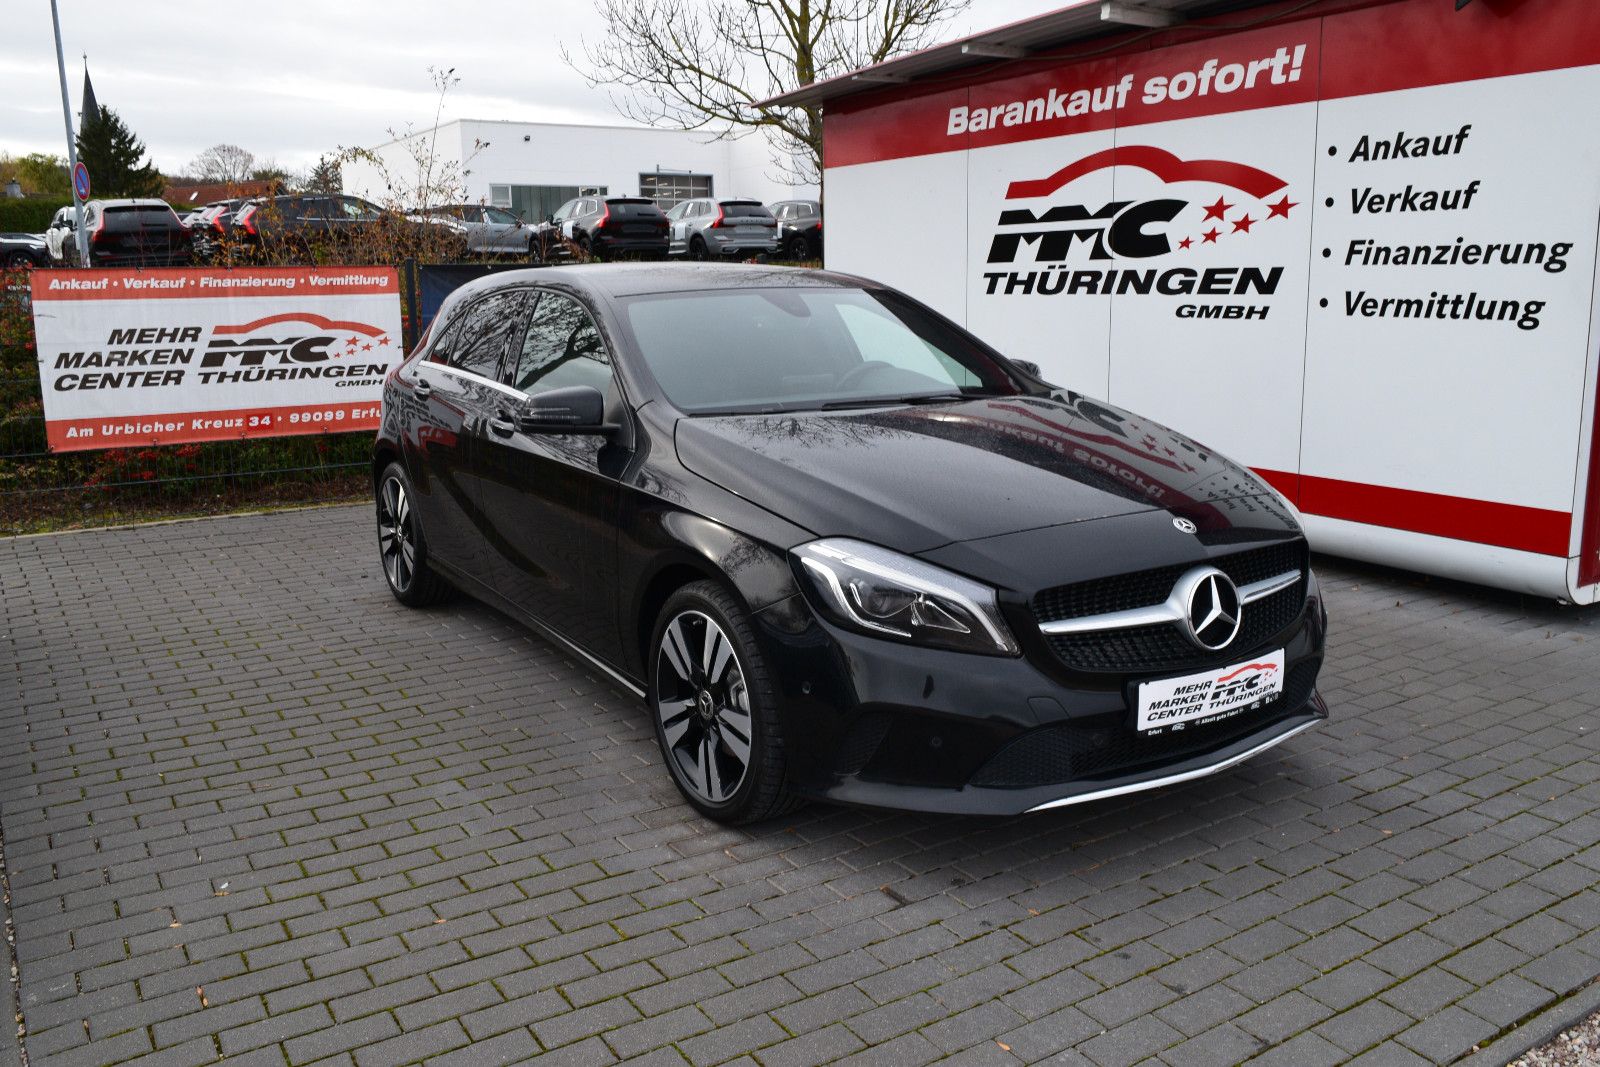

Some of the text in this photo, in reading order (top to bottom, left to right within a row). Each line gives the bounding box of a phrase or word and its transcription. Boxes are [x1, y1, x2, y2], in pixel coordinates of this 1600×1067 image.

[947, 44, 1307, 136] Barankauf sofort!
[1348, 124, 1472, 163] Ankauf
[1351, 180, 1481, 214] Verkauf
[1344, 236, 1574, 273] Finanzierung
[49, 274, 389, 290] Ankauf Verkauf Finanzierung Vermittlung
[983, 264, 1285, 296] THÜRINGEN
[1175, 304, 1270, 320] GMBH
[1344, 290, 1546, 331] Vermittlung
[107, 326, 202, 345] MEHR
[54, 348, 195, 369] MARKEN
[54, 370, 185, 392] CENTER
[198, 363, 388, 384] THÜRINGEN
[335, 379, 384, 387] GMBH
[66, 427, 94, 438] Am
[102, 421, 185, 436] Urbicher
[192, 417, 243, 430] Kreuz
[248, 415, 271, 427] 34
[289, 410, 345, 423] 99099
[1173, 680, 1213, 696] MEHR
[1148, 691, 1208, 711] MARKEN
[1147, 703, 1203, 721] CENTER
